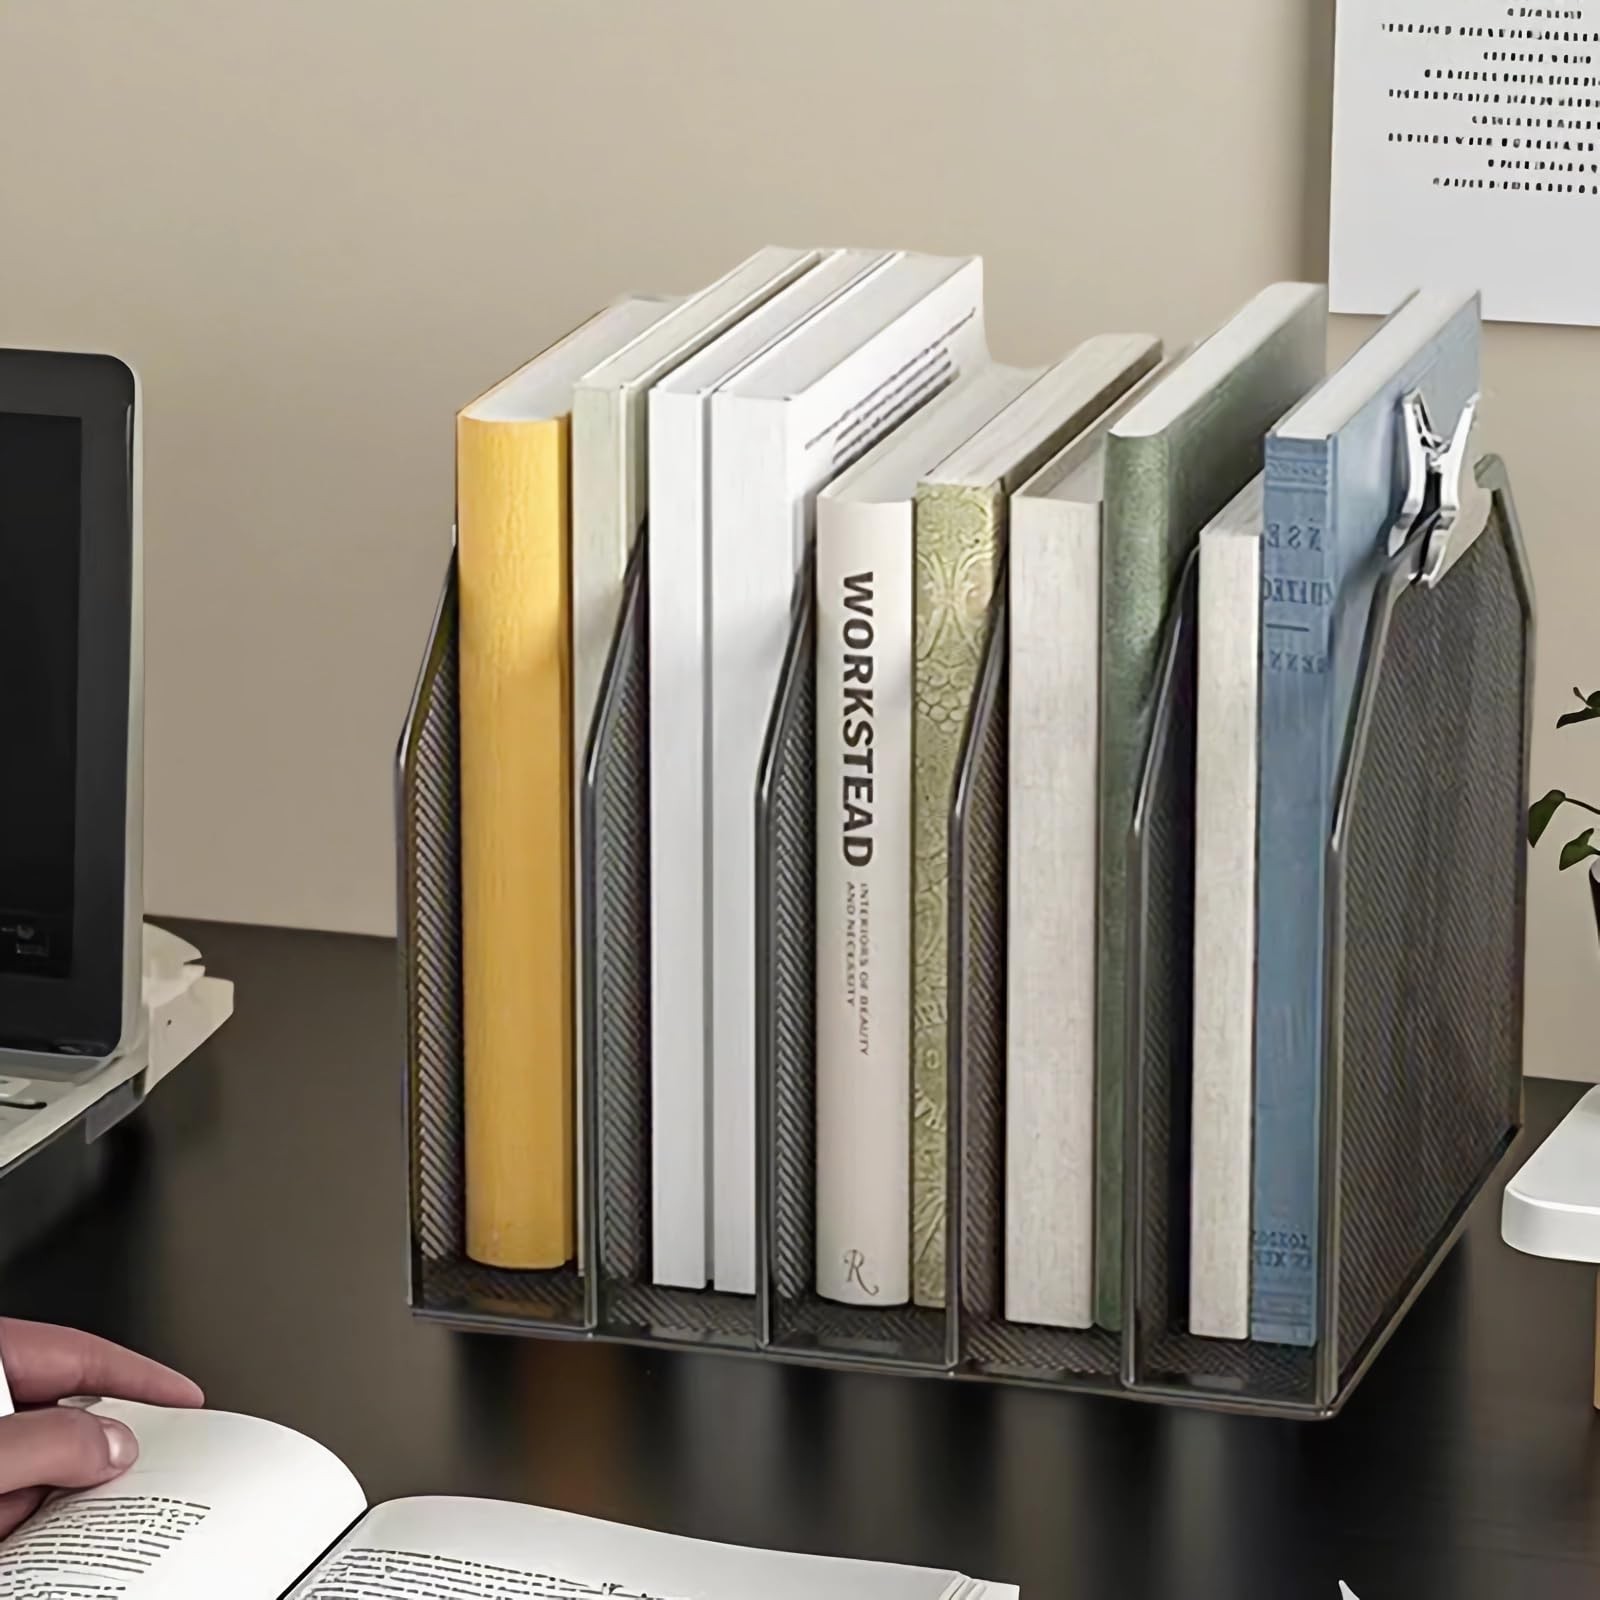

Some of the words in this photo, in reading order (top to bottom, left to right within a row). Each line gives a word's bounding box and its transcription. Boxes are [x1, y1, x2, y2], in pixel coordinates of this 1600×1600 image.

[843, 571, 874, 867] WORKSTEAD
[846, 881, 856, 915] AND
[859, 882, 870, 966] INTERIORS
[859, 971, 870, 990] OF
[859, 995, 870, 1056] BEAUTY
[843, 1249, 880, 1296] R
